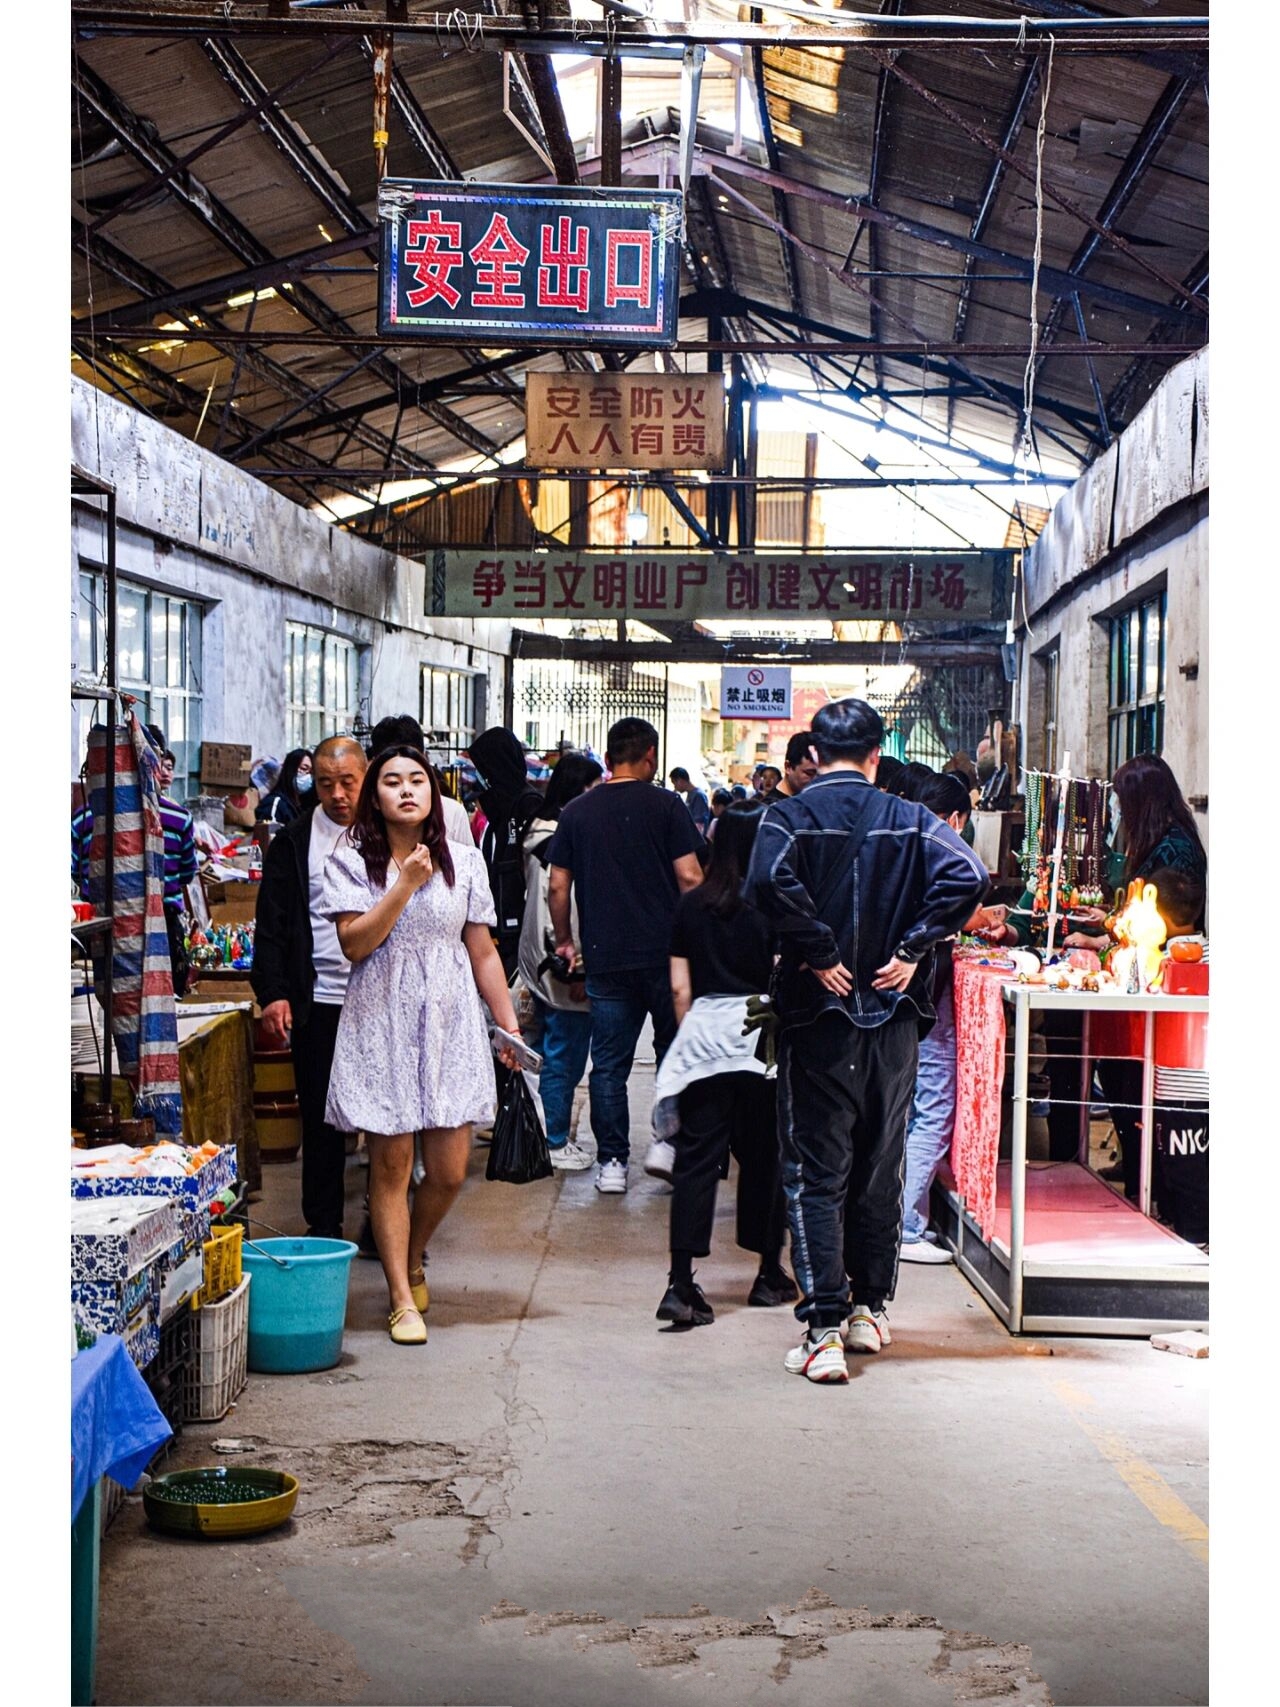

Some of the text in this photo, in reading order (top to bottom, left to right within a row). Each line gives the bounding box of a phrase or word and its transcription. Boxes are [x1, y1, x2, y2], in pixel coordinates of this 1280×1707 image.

[404, 209, 654, 313] 安全出口
[546, 385, 706, 420] 安全防火
[547, 422, 706, 456] 人人有责
[473, 559, 967, 612] 争当文明业户 创建文明市场
[726, 687, 786, 704] 禁止吸烟
[727, 704, 784, 712] NO SMOKING
